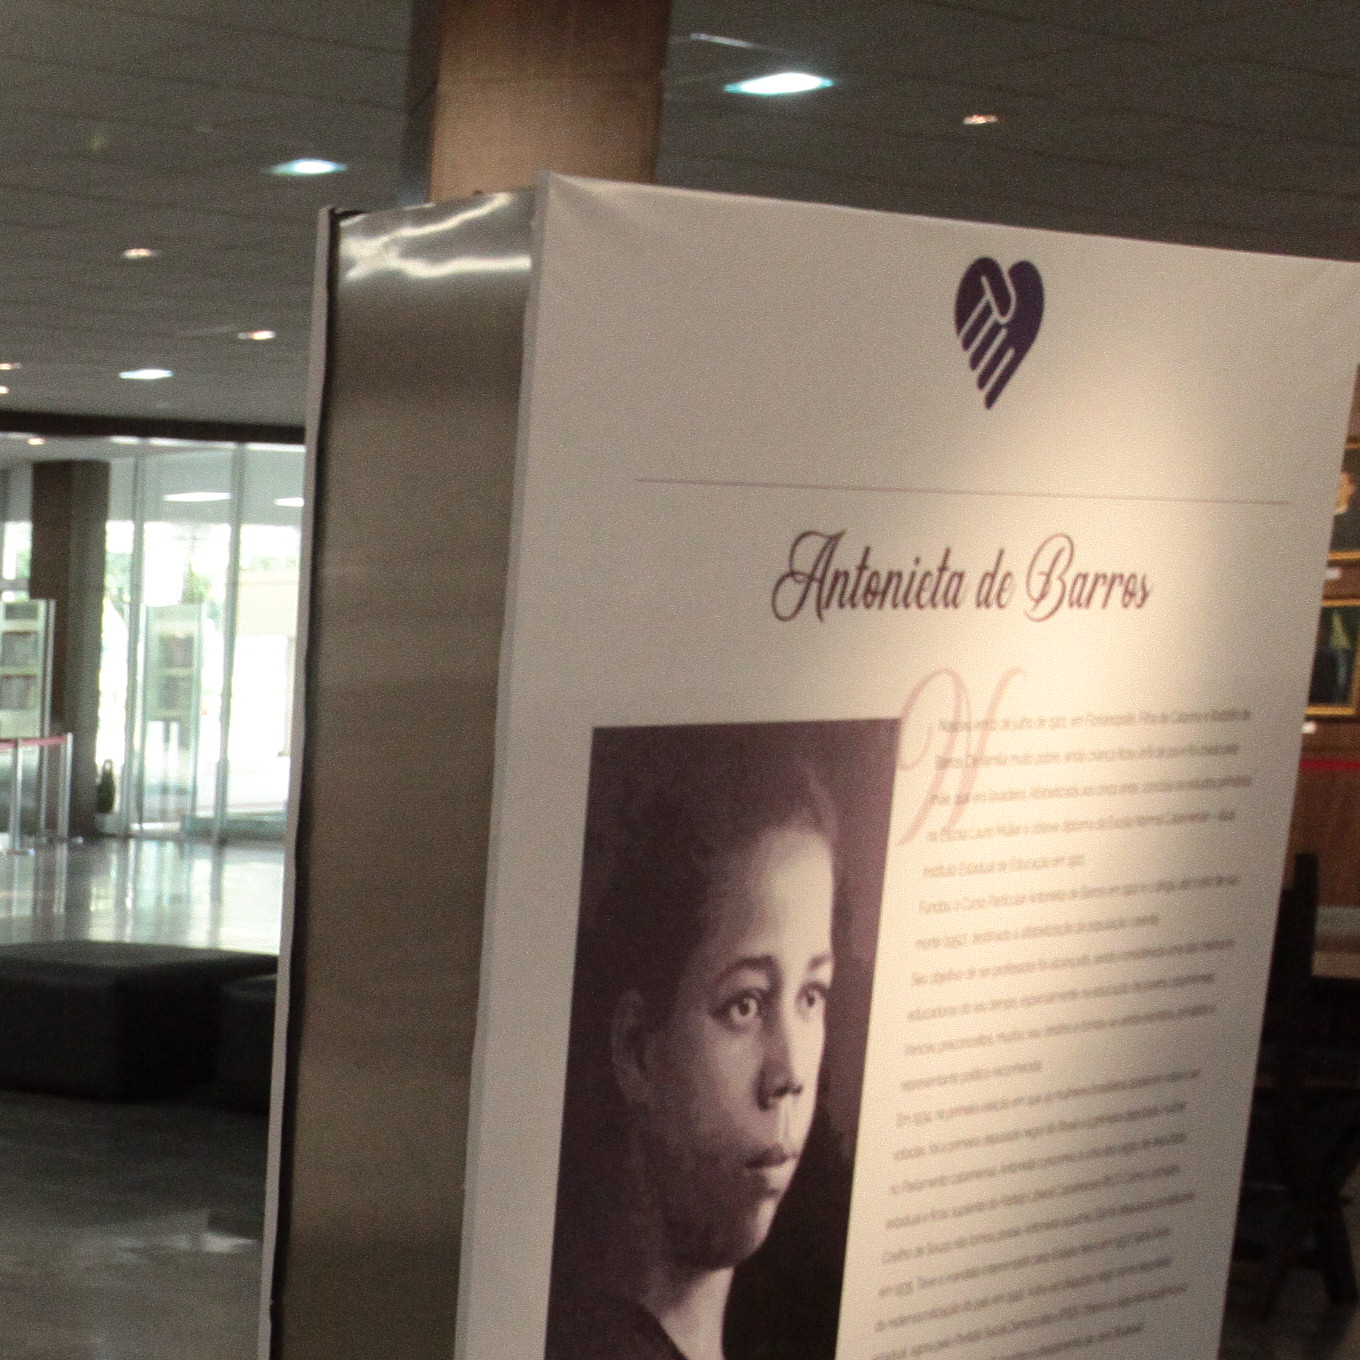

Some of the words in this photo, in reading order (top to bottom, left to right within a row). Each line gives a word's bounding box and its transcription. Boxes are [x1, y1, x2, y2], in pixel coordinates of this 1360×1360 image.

[771, 529, 967, 623] Antonieta
[974, 548, 1014, 610] de
[1023, 533, 1152, 623] Barros
